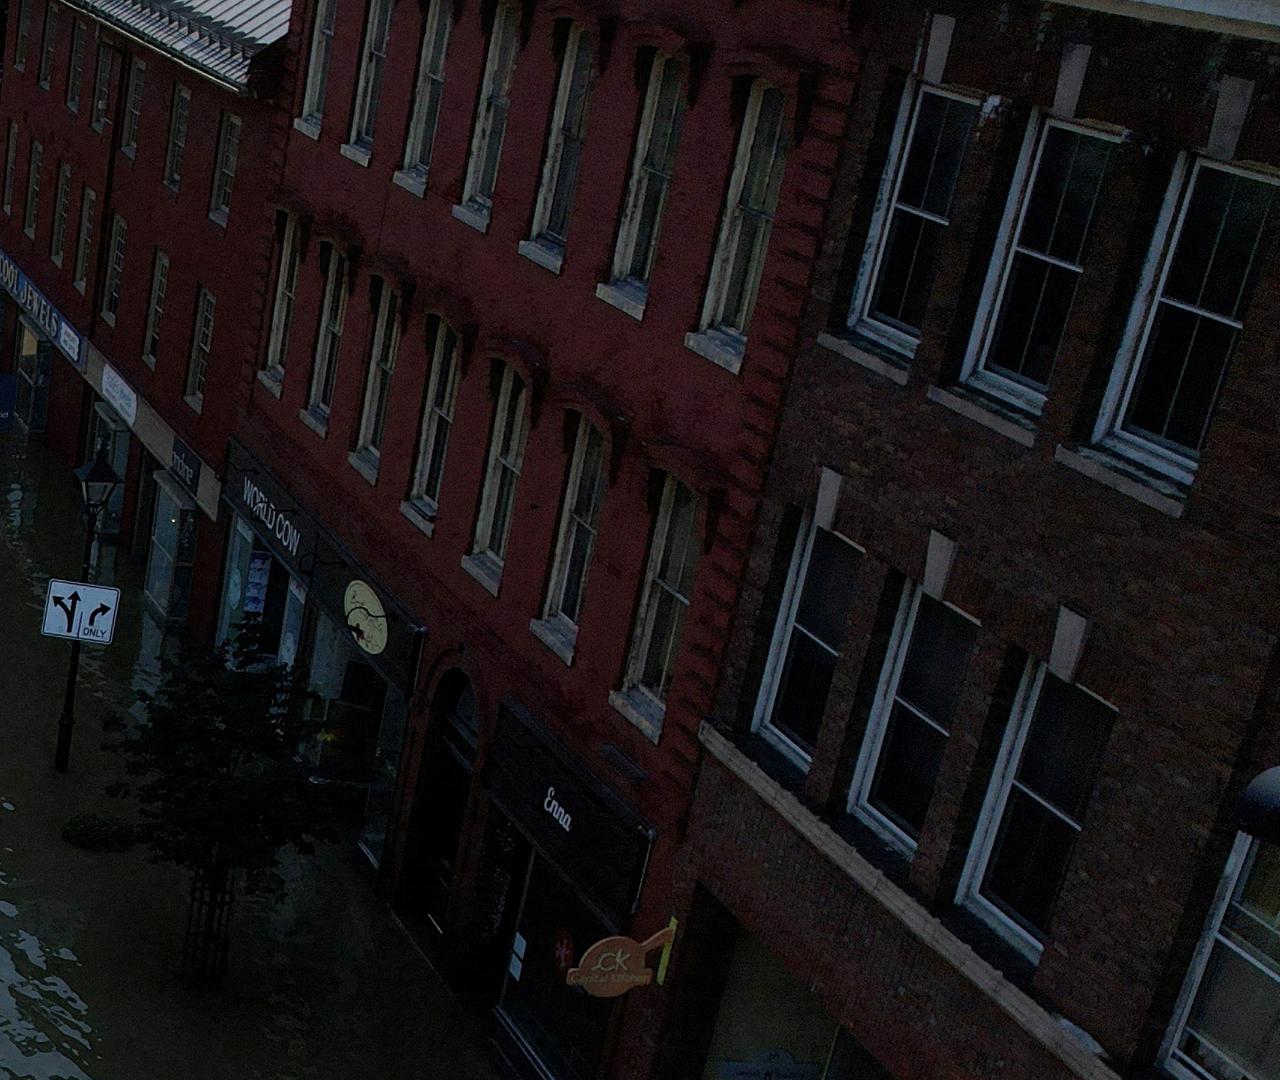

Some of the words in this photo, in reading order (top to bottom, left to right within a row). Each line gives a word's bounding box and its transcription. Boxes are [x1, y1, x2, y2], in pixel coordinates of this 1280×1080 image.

[20, 281, 59, 337] JEWELS
[243, 475, 276, 530] WORLD
[276, 513, 301, 556] COW
[83, 627, 107, 638] ONLY
[544, 786, 572, 832] Enna
